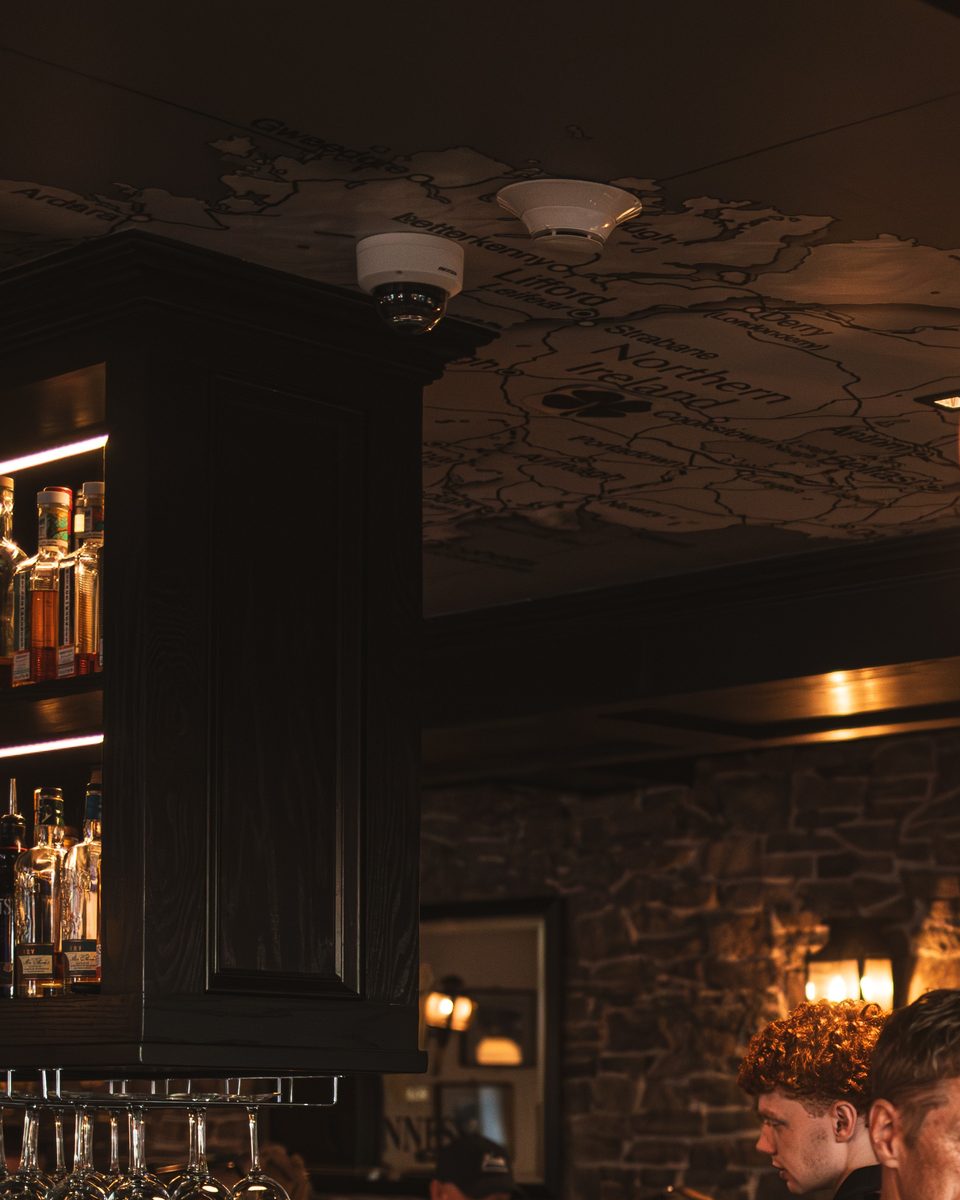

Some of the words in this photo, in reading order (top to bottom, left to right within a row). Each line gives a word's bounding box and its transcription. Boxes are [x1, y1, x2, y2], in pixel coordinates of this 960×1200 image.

[11, 187, 118, 221] Ardara
[392, 212, 556, 265] Letterkenny
[493, 268, 617, 307] Lifford
[604, 324, 720, 361] Strabane
[759, 310, 833, 337] Derry
[565, 361, 738, 410] Ireland
[590, 343, 792, 404] Northern
